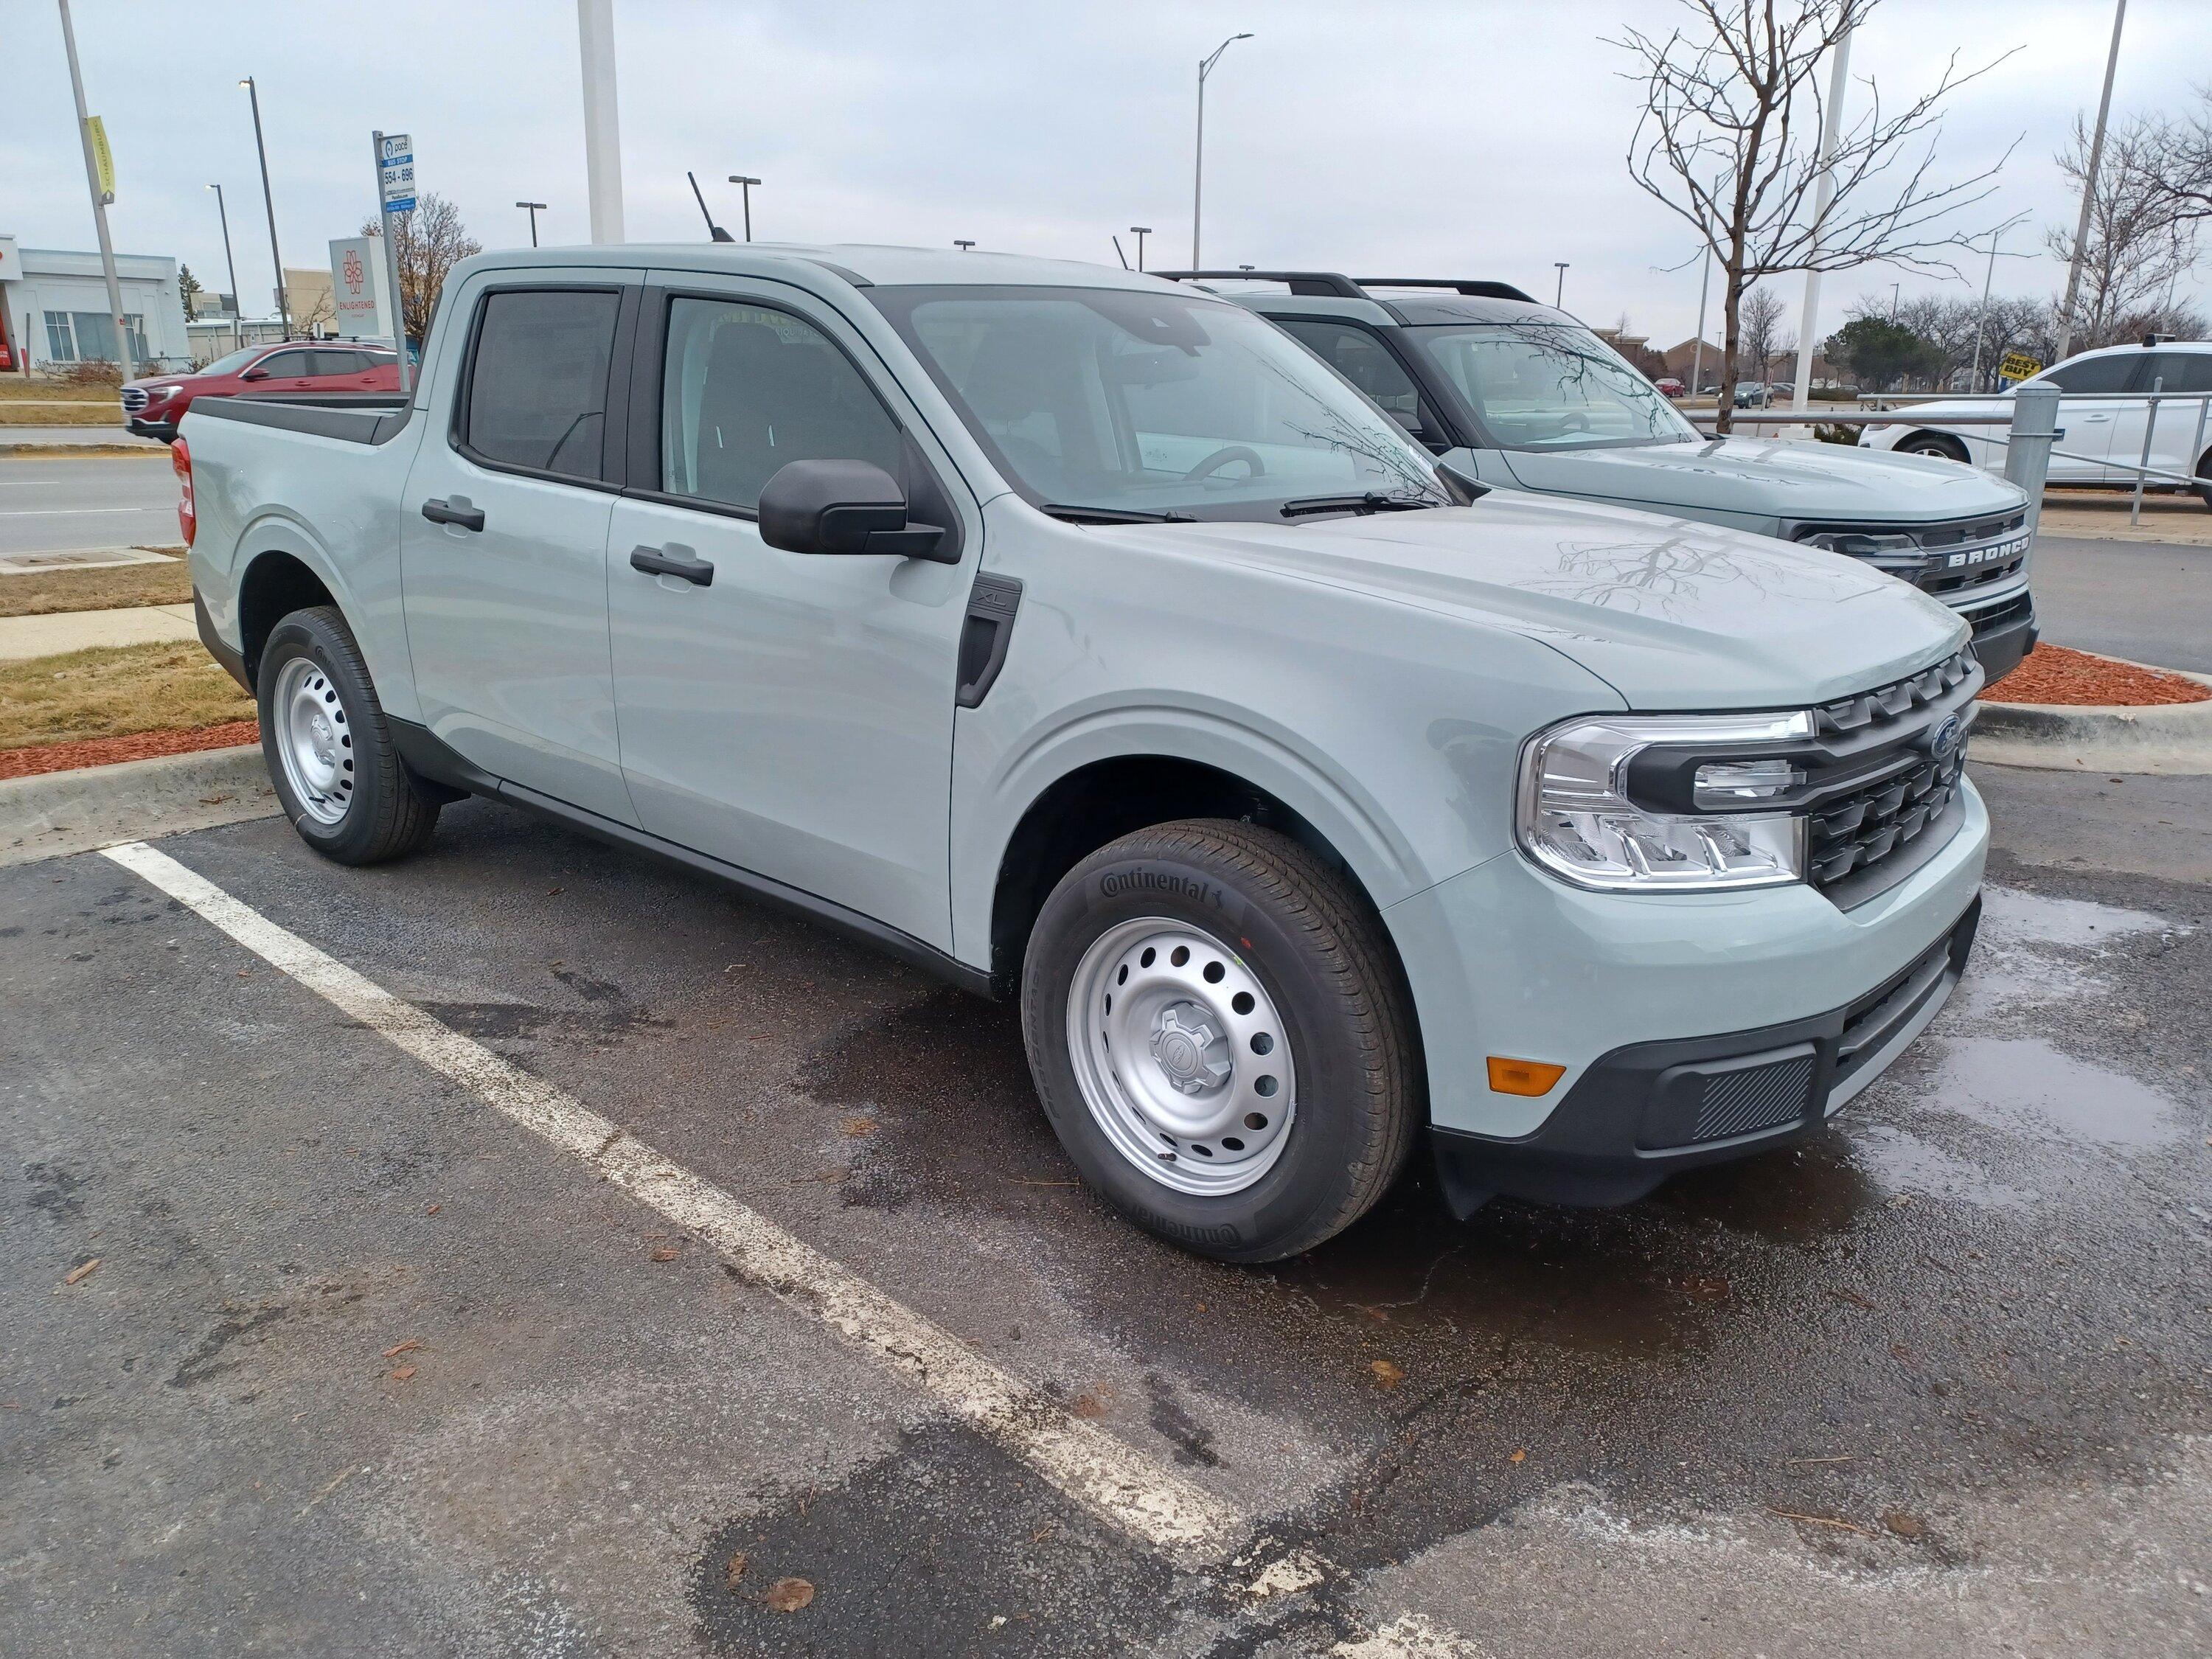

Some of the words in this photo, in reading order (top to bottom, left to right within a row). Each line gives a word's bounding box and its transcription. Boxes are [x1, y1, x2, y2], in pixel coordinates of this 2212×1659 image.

[94, 120, 111, 187] SCHAUMBURG
[394, 141, 408, 153] pace
[385, 170, 397, 184] 554
[401, 167, 414, 182] 696
[339, 300, 375, 310] ENLIGHTENED
[2004, 364, 2032, 377] BUY
[2006, 356, 2039, 370] BEST
[1948, 536, 2029, 568] BRONCO
[976, 589, 1007, 608] XL
[1099, 866, 1209, 904] Continental
